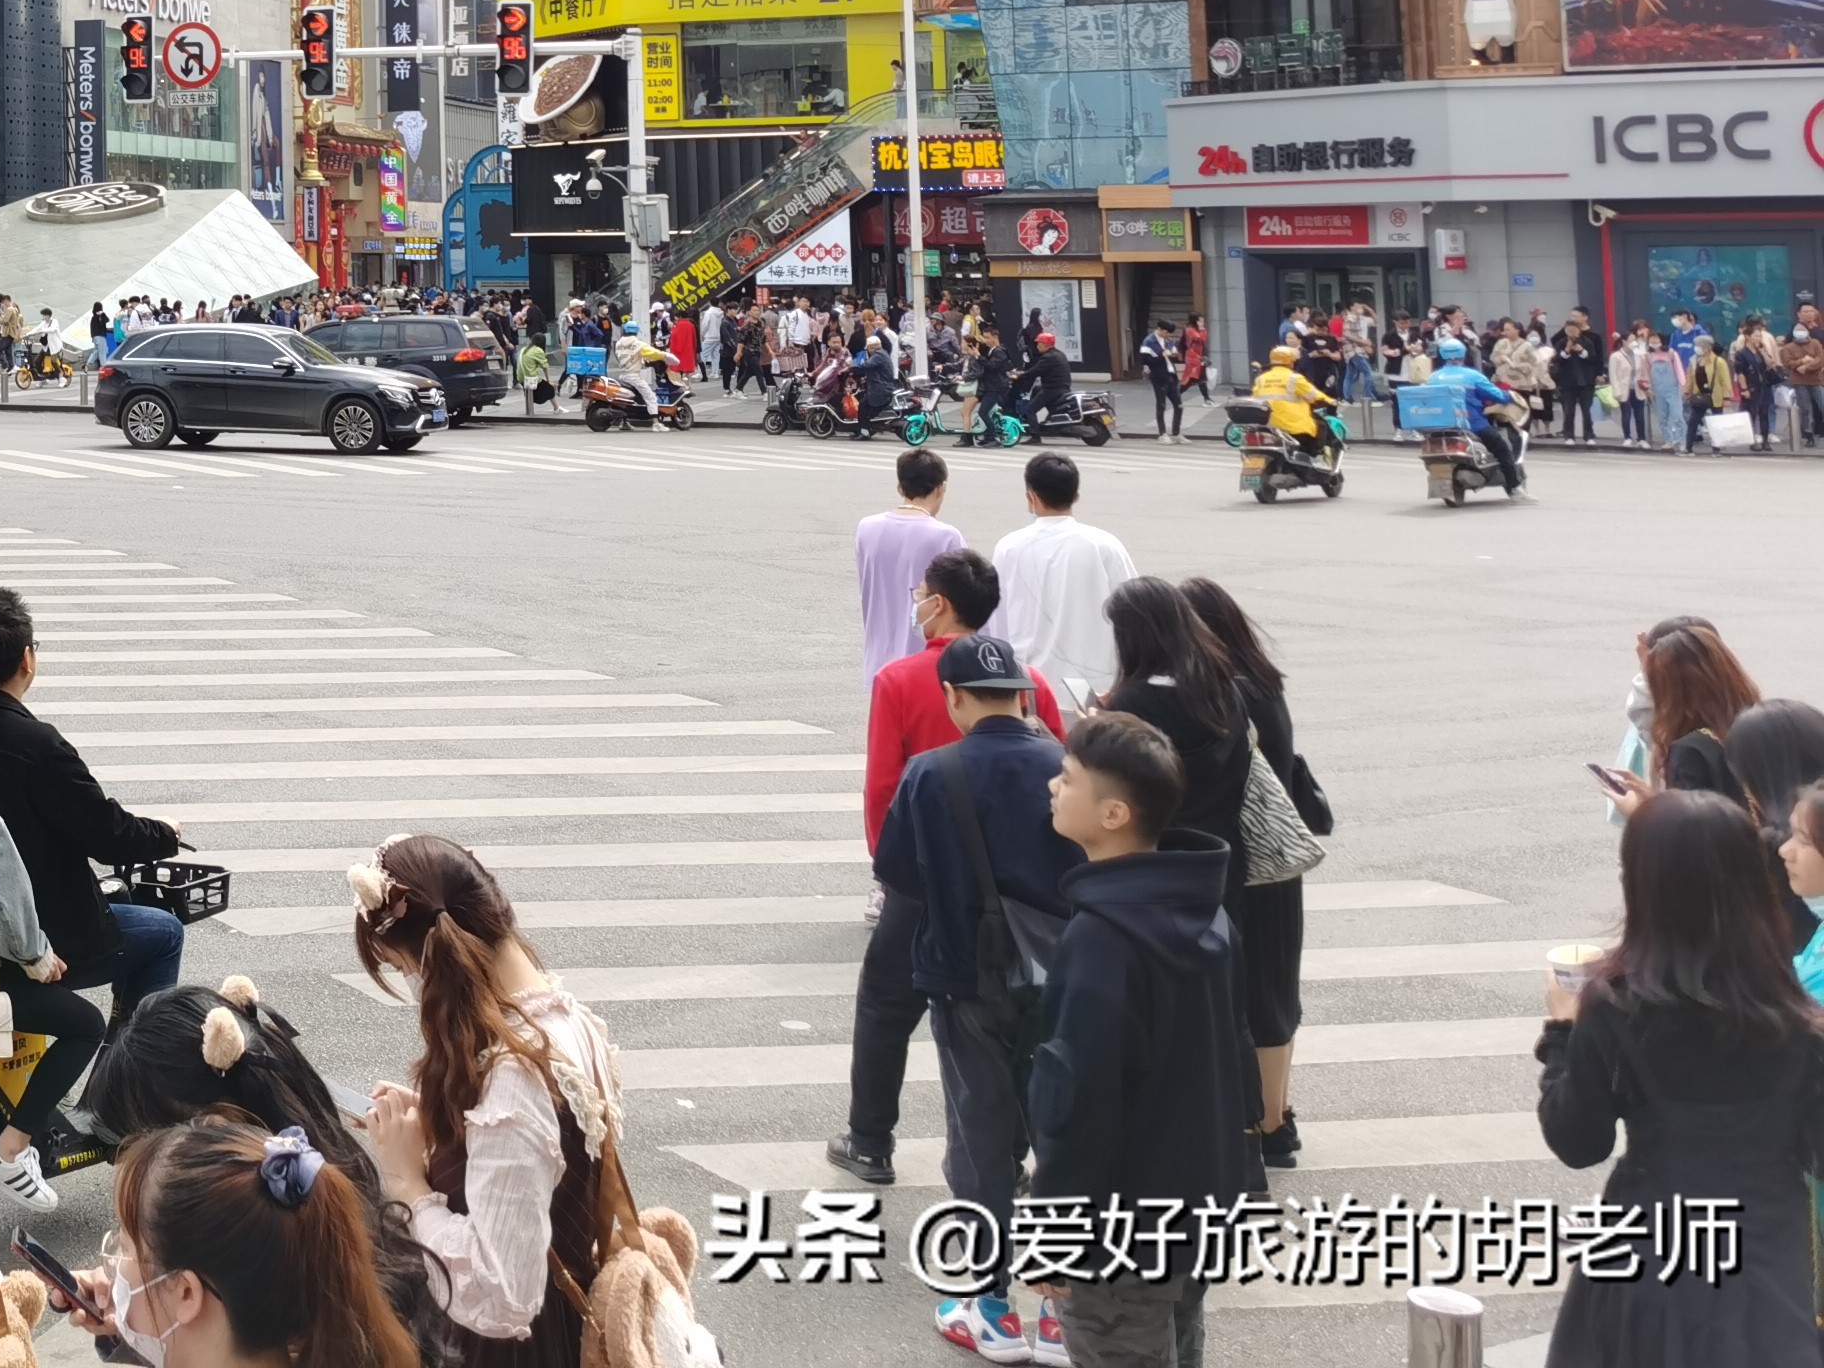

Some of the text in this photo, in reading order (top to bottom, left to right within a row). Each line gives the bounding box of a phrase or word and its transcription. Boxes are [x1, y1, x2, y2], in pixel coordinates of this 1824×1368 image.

[647, 41, 672, 55] 营业
[647, 79, 673, 87] 11:00
[171, 93, 216, 105] 公交车除外
[647, 96, 674, 104] 02:00
[79, 46, 97, 185] Meters/bonwe
[1592, 110, 1772, 164] ICBC
[1197, 135, 1416, 177] 24h 自助银行服务
[384, 156, 399, 226] 中国黄金
[1108, 219, 1184, 237] 西畔花园
[1258, 215, 1293, 237] 24h
[1388, 233, 1411, 242] ICBC
[661, 249, 725, 305] 炊烟
